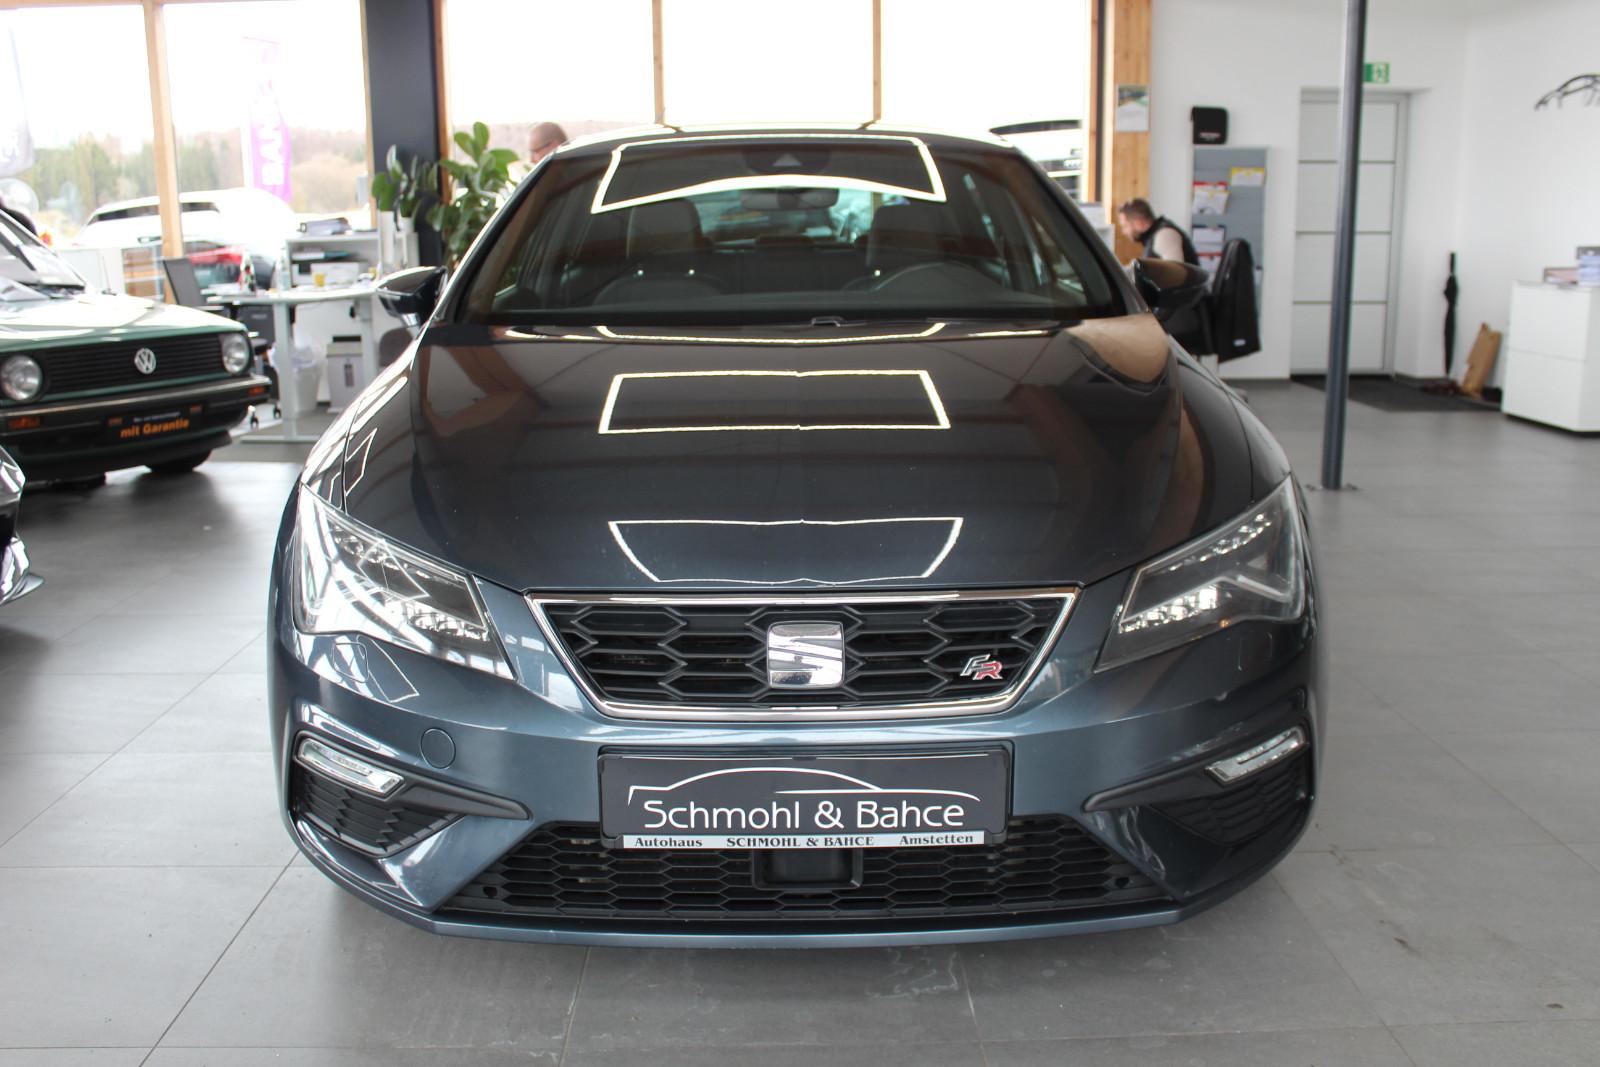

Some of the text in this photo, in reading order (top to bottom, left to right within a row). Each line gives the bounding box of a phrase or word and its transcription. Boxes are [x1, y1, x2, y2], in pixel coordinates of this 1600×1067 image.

[120, 424, 141, 439] mit
[143, 417, 190, 435] Garantie
[960, 653, 1004, 681] FR
[643, 800, 965, 829] Schmohl & Bahce
[634, 833, 974, 848] Autohaus SCHMOHL & BAHCE Amstetten
